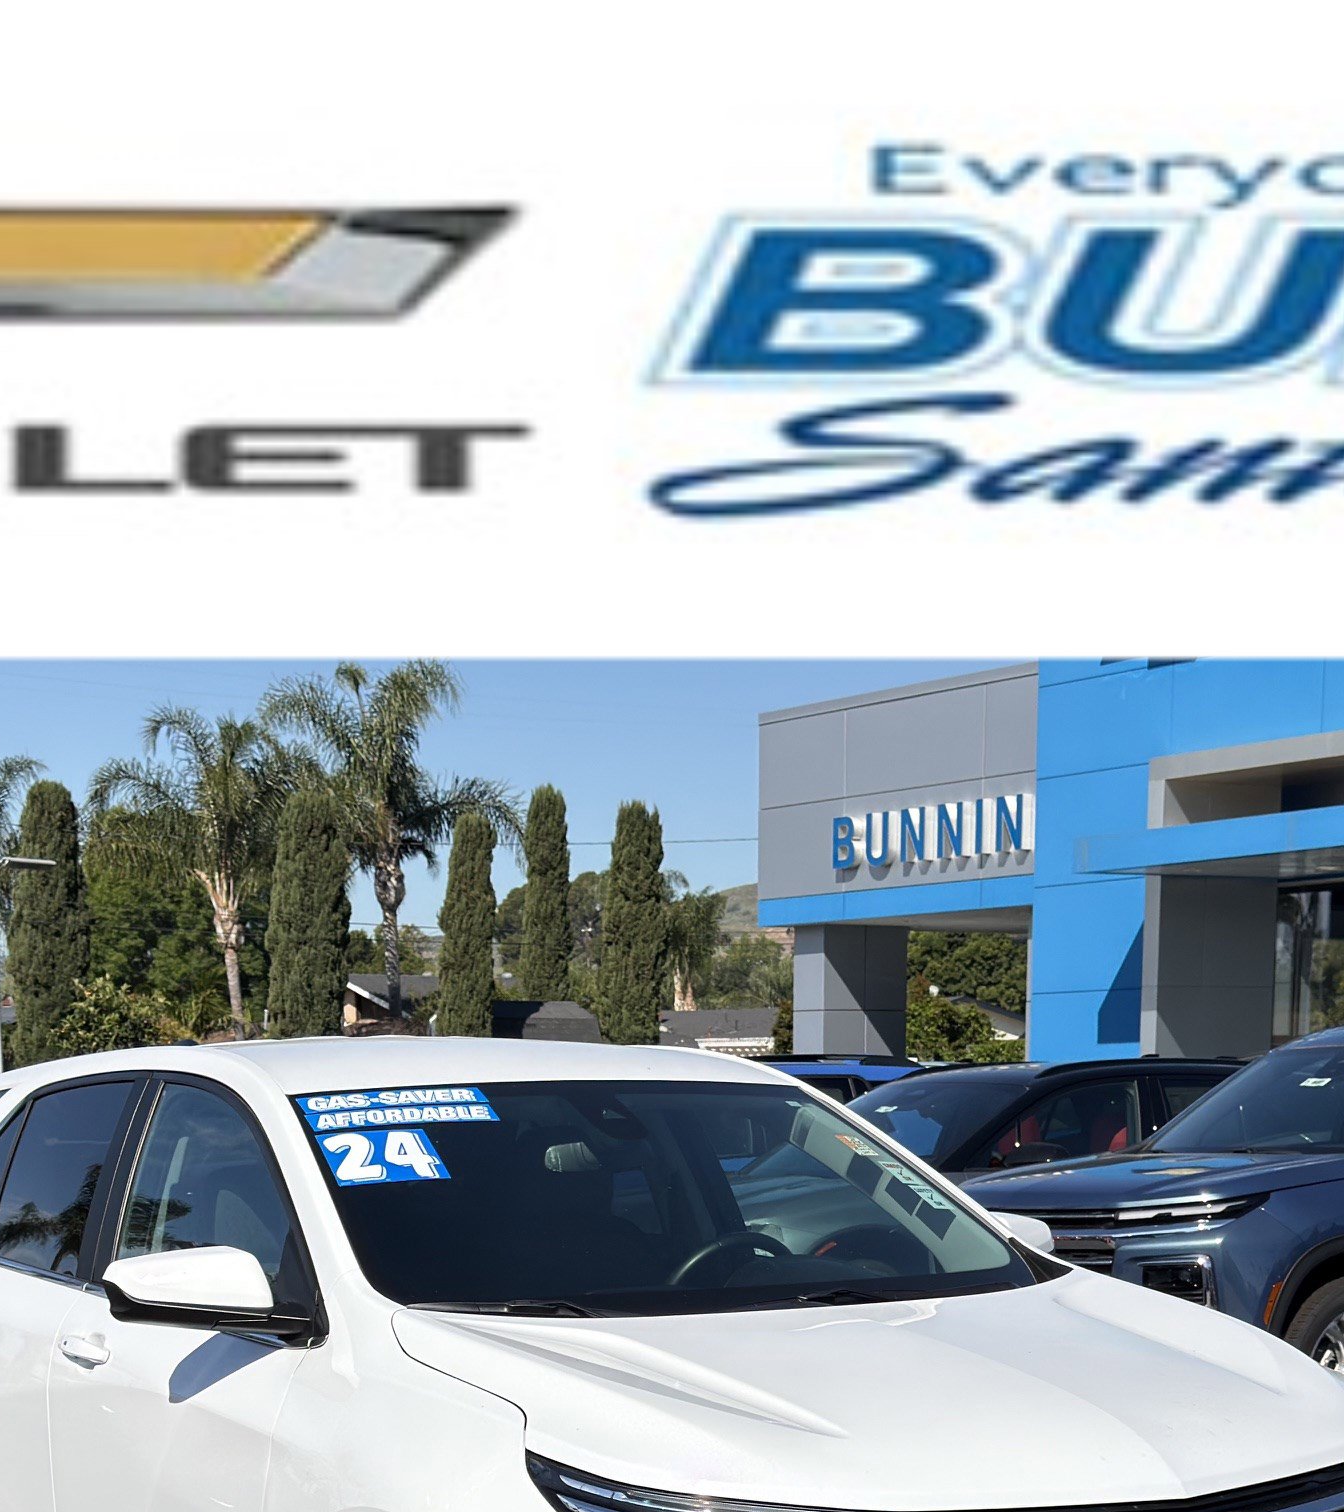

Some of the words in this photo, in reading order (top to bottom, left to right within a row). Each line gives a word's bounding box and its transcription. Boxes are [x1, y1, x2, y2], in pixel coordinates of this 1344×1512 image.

[832, 794, 1032, 870] BUNNIN
[307, 1088, 478, 1111] GAS-SAVER
[317, 1105, 492, 1129] AFFORDABLE
[323, 1131, 441, 1183] 24
